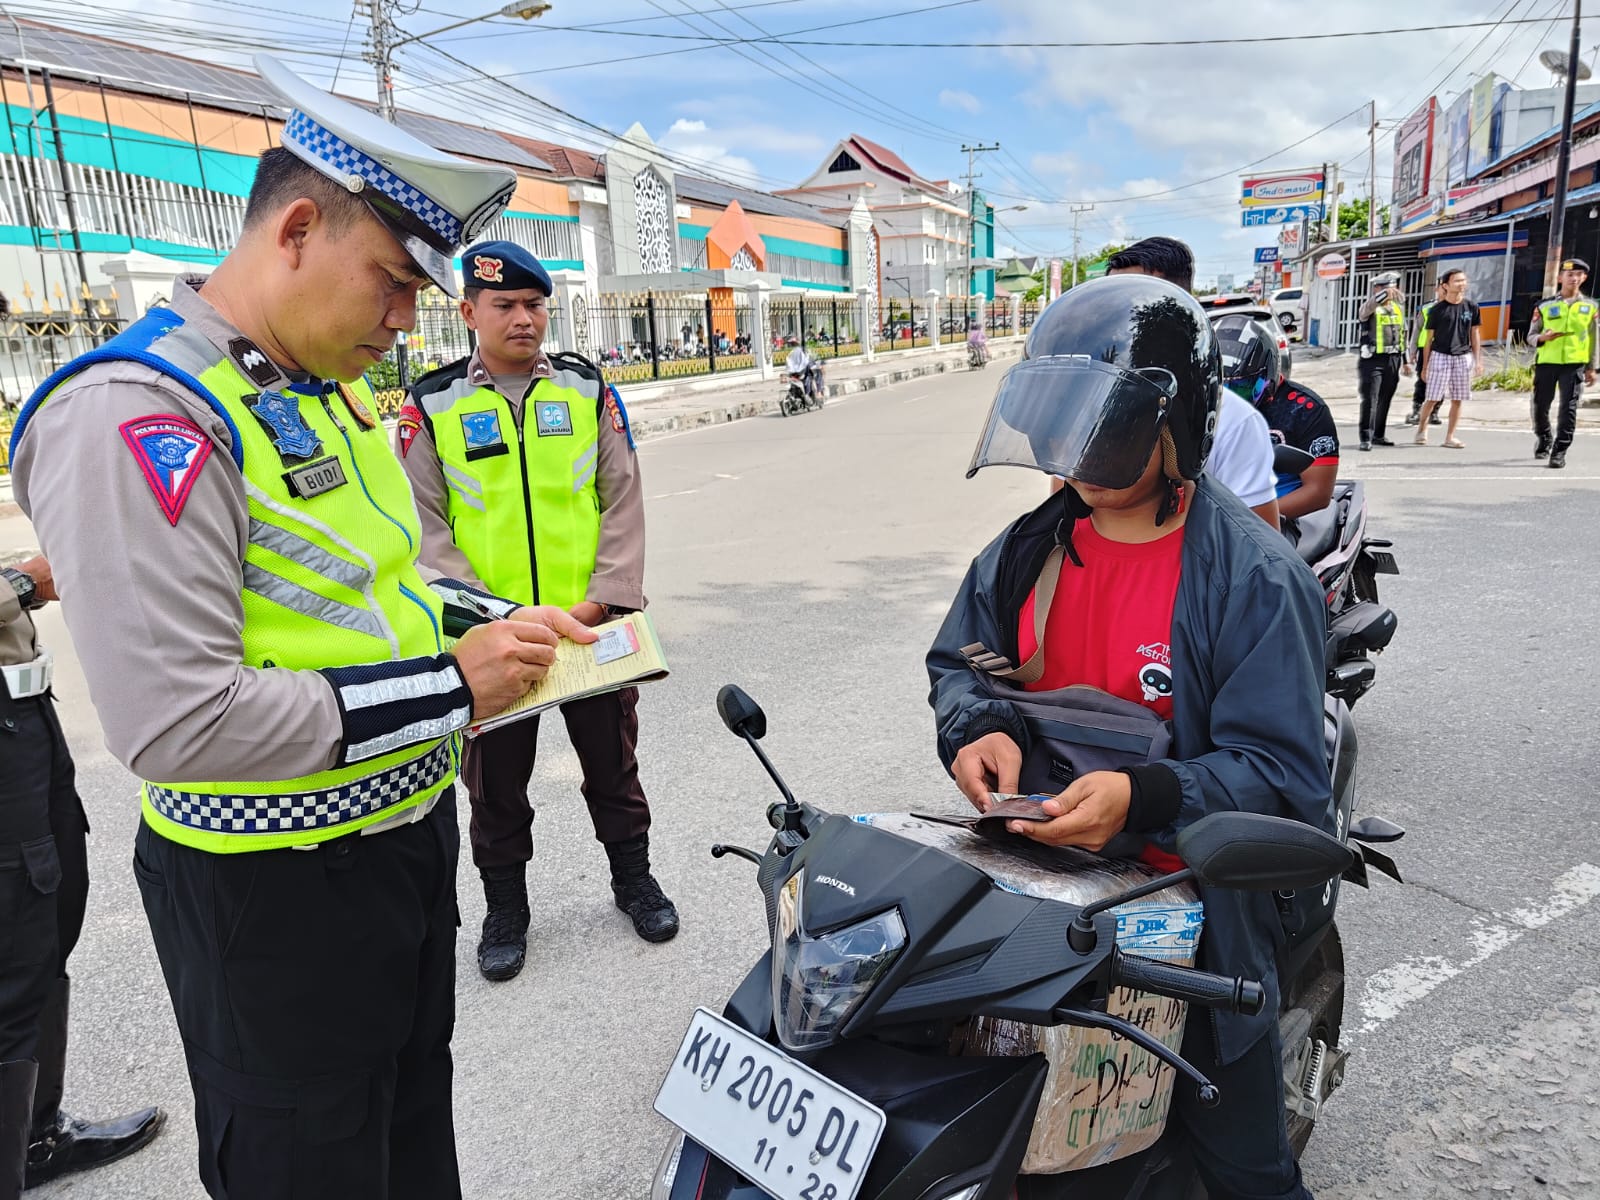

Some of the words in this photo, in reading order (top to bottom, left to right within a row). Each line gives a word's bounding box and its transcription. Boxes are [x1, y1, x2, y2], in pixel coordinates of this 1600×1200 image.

[304, 466, 339, 490] BUDI
[814, 874, 856, 897] HONDA
[683, 1026, 731, 1086] KH
[727, 1055, 814, 1137] 2005
[815, 1106, 859, 1174] DL
